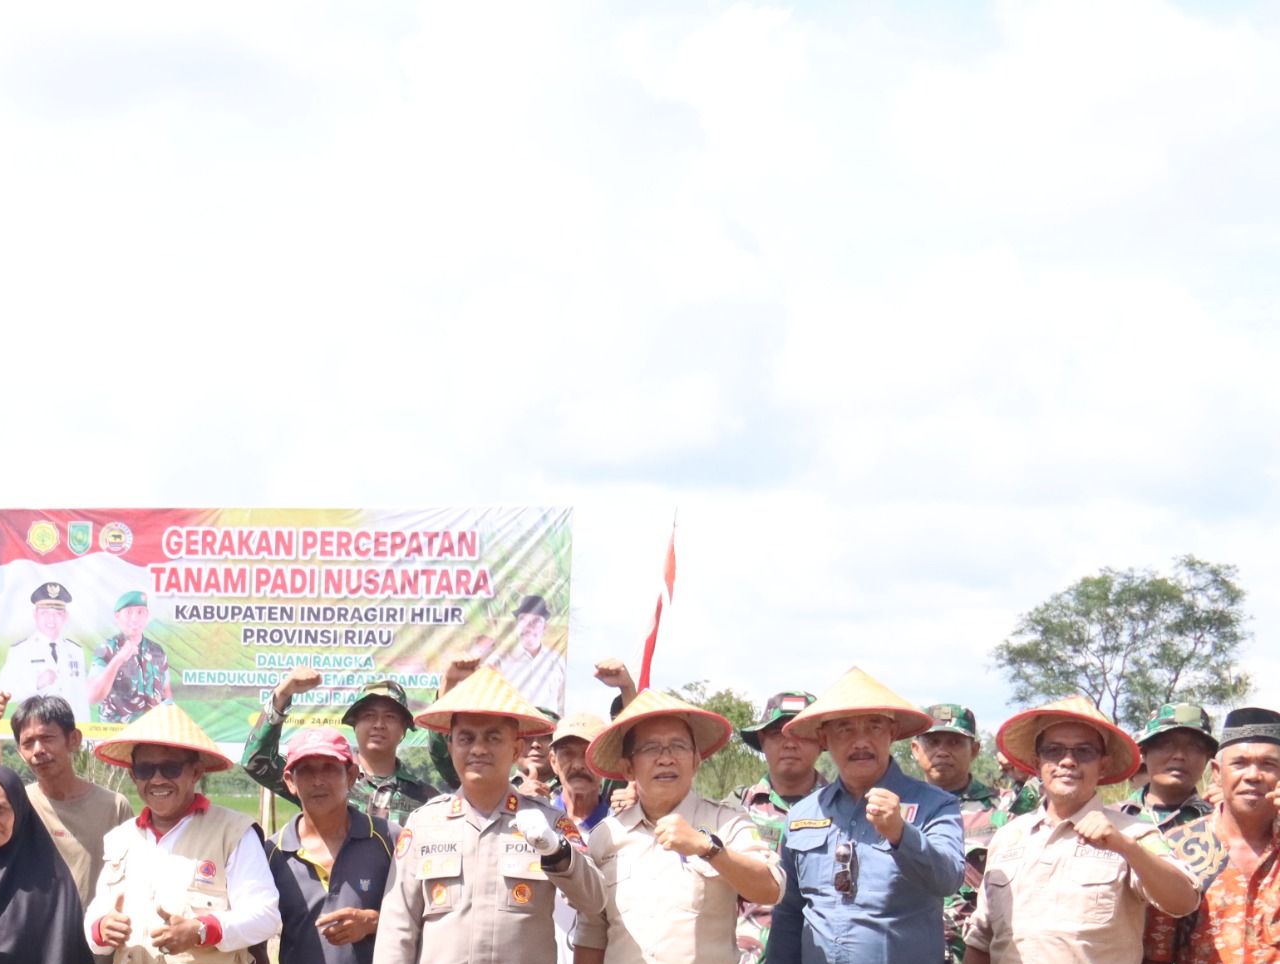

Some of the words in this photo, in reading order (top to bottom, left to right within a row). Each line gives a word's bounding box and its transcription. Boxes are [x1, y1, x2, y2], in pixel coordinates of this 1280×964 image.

[164, 528, 294, 557] GERAKAN
[301, 530, 477, 558] PERCEPATAN
[150, 566, 247, 594] TANAM
[255, 567, 316, 594] PADI
[324, 568, 492, 596] NUSANTARA
[175, 605, 294, 622] KABUPATEN
[300, 606, 404, 623] INDRAGIRI
[410, 607, 464, 624] HILIR
[242, 628, 338, 646] PROVINSI
[344, 629, 393, 646] RIAU
[256, 655, 309, 668] DALAM
[312, 655, 374, 669] RANGKA
[184, 671, 278, 685] MENDUKUNG
[389, 674, 442, 687] PANGA
[261, 690, 329, 704] PVINSI
[334, 692, 358, 704] RIA
[421, 843, 458, 855] FAROUK
